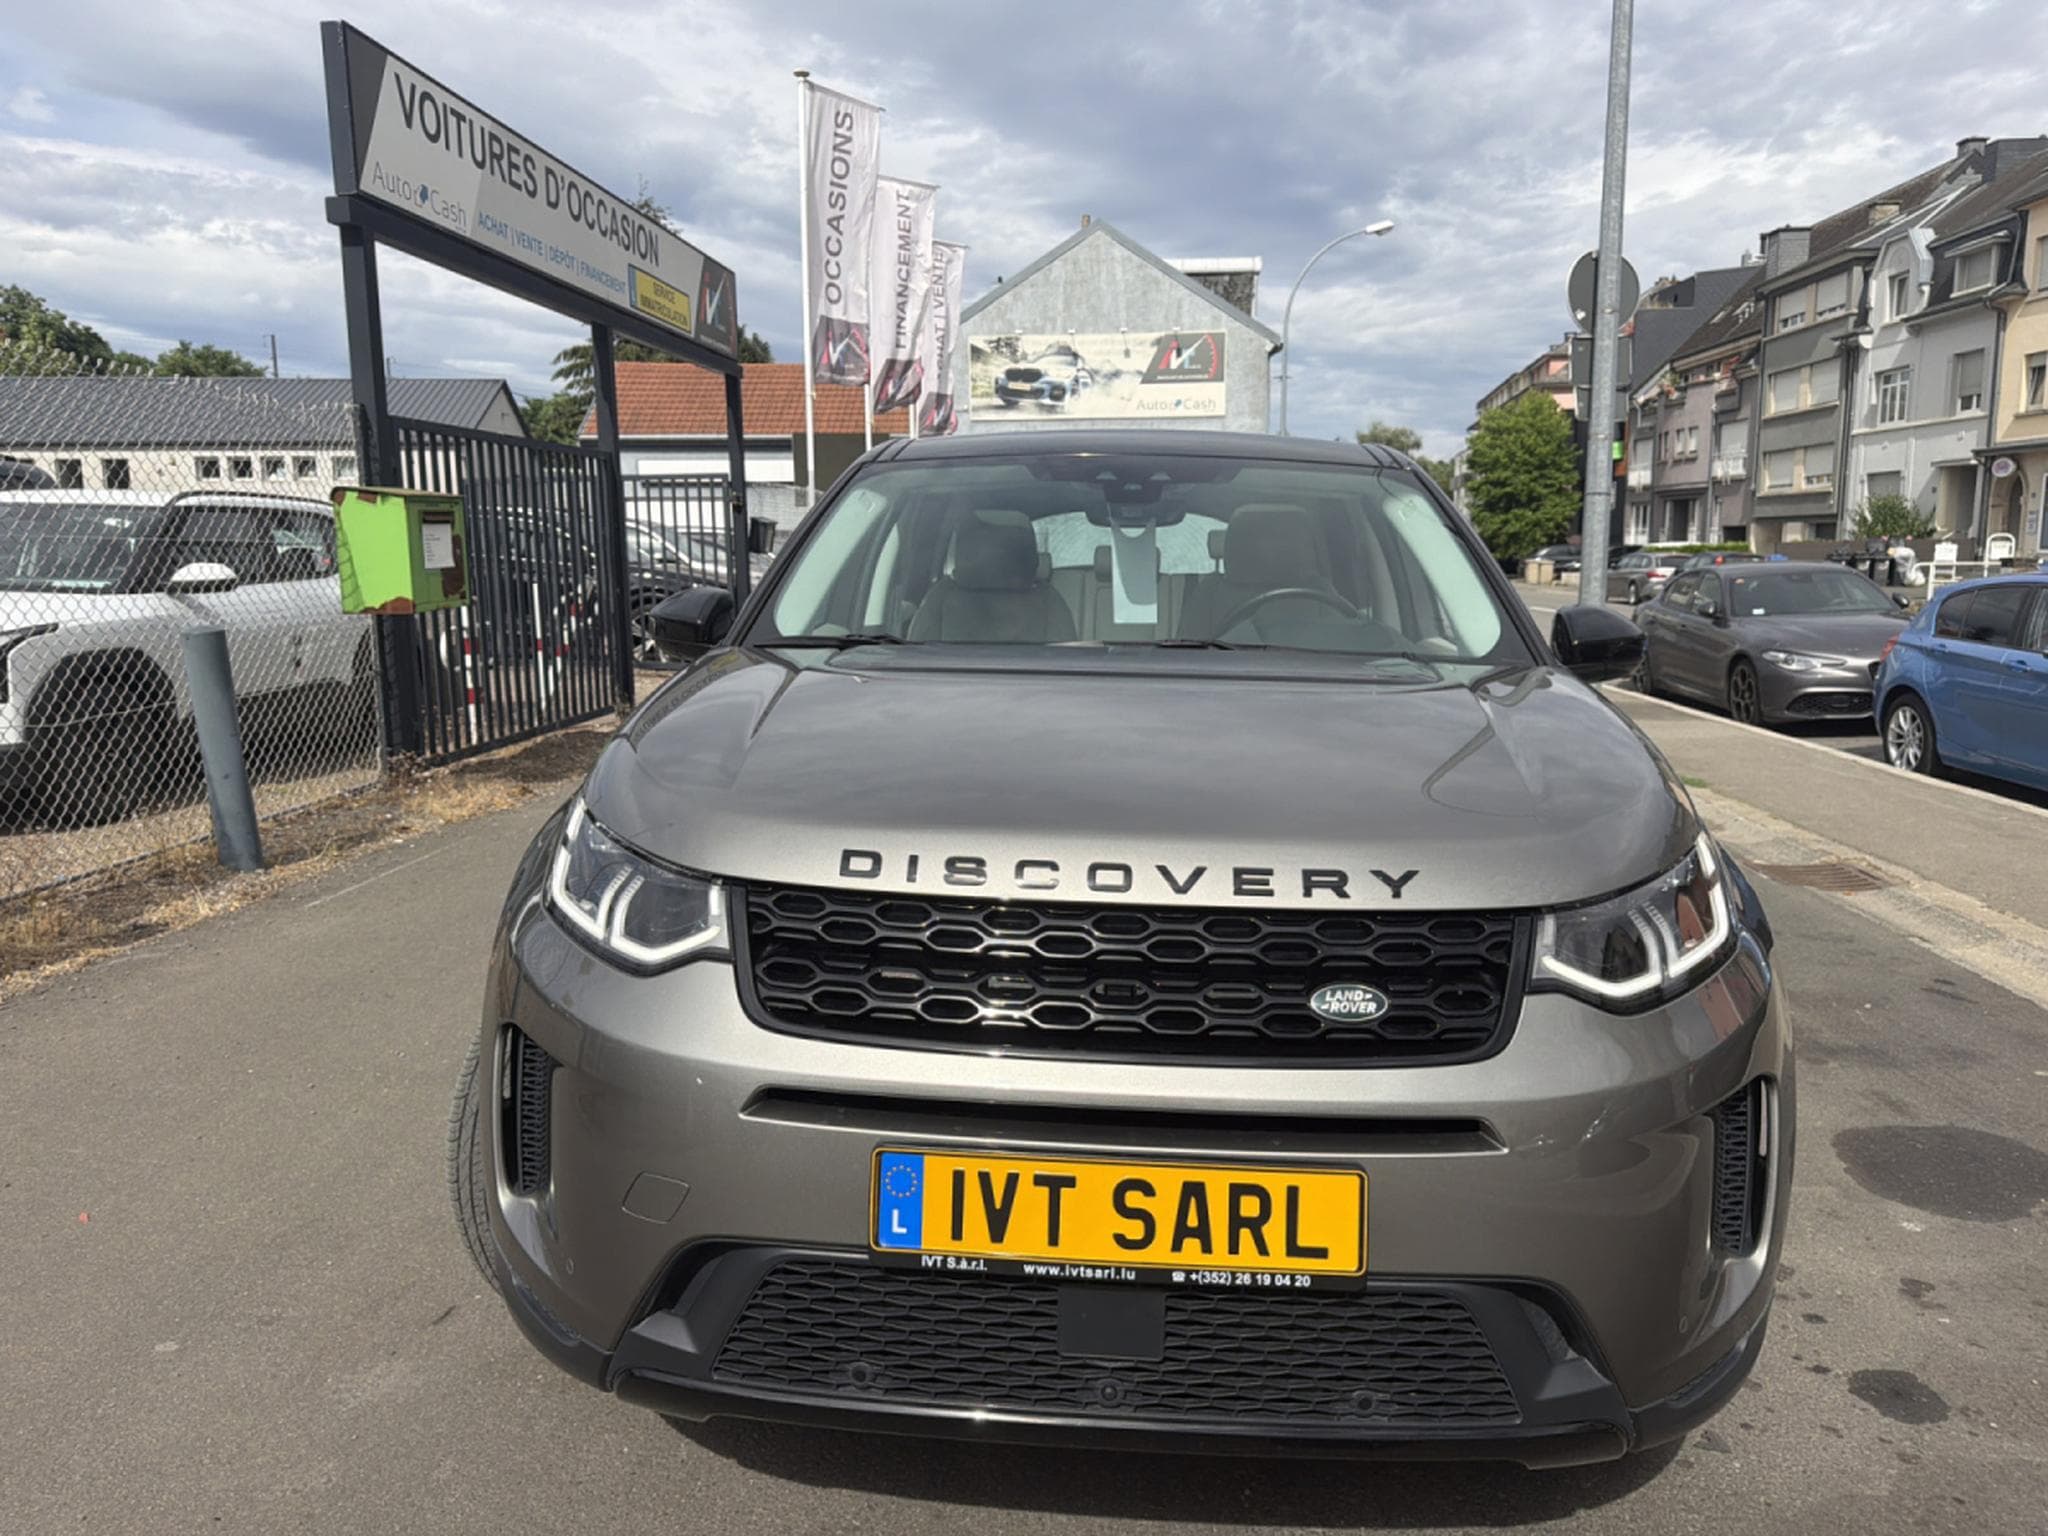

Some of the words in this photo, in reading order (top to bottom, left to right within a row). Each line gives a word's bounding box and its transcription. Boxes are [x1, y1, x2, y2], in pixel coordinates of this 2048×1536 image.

[394, 71, 538, 199] VOITURES
[545, 165, 660, 267] D'OCCASION
[372, 161, 412, 201] Auto
[430, 188, 466, 227] Cash
[824, 109, 854, 306] OCCASIONS
[478, 211, 509, 240] ACHAT
[515, 229, 544, 257] VENTE
[895, 189, 912, 350] FINANCEMENT
[839, 848, 1421, 899] DISCOVERY
[1325, 989, 1364, 1002] LAND
[1329, 1001, 1377, 1014] ROVER
[891, 1208, 908, 1234] L
[950, 1168, 1077, 1248] IVT
[1111, 1177, 1330, 1260] SARL
[921, 1254, 944, 1269] IVT
[1022, 1263, 1137, 1280] www.ivtsarl.lu
[1189, 1271, 1232, 1286] +(352)
[1235, 1272, 1252, 1285] 26
[1255, 1273, 1272, 1286] 19
[1274, 1274, 1291, 1287] 04
[1294, 1275, 1312, 1288] 20
